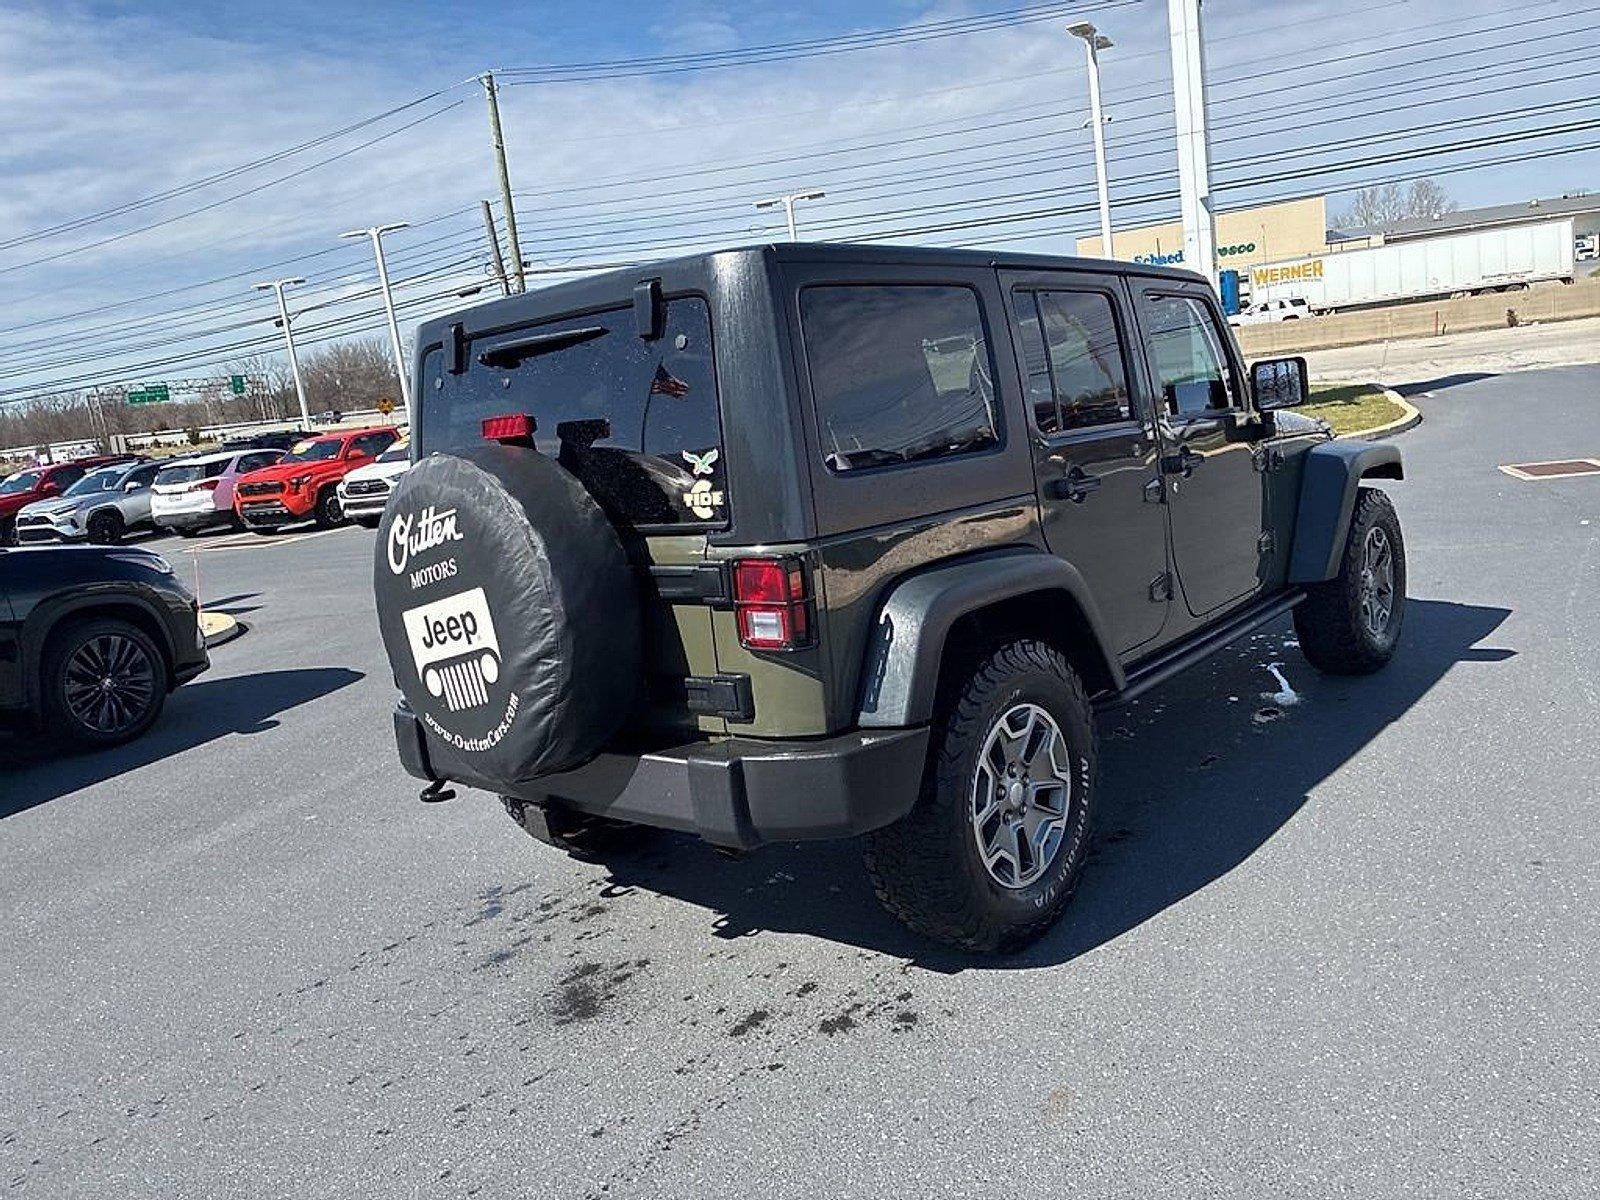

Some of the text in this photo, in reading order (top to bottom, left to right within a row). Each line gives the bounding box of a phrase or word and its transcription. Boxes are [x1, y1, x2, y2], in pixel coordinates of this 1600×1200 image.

[1252, 259, 1324, 285] WERNER
[409, 557, 458, 590] MOTORS
[422, 610, 477, 649] Jeep
[424, 692, 520, 752] www.OuttenCars.com
